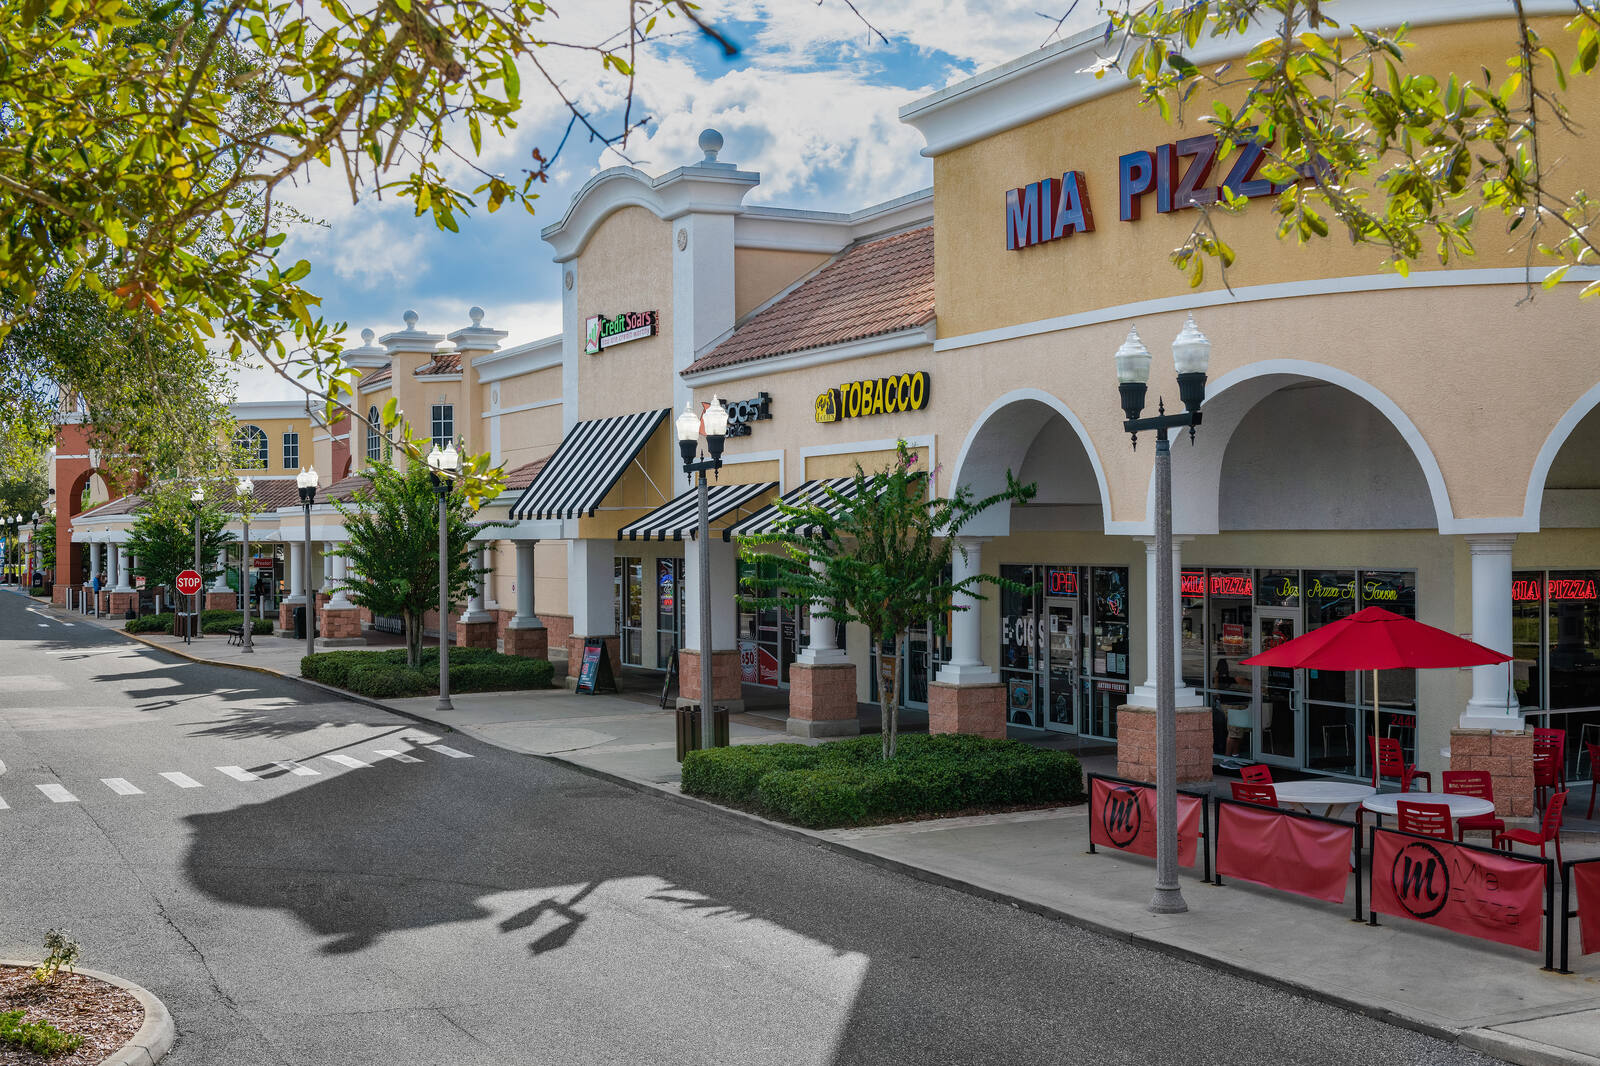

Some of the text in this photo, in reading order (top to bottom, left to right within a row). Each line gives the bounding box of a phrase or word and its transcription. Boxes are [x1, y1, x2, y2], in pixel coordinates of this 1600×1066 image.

[1005, 171, 1095, 250] MIA
[600, 311, 652, 337] Credit Soars
[840, 371, 930, 418] TOBACCO
[722, 392, 772, 424] oost
[178, 577, 201, 588] STOP
[1052, 573, 1078, 592] OPEN
[1210, 577, 1253, 595] PIZZA
[1307, 579, 1339, 598] Pizza
[1362, 581, 1398, 600] Town
[1545, 580, 1597, 599] PIZZA
[742, 651, 755, 665] $50
